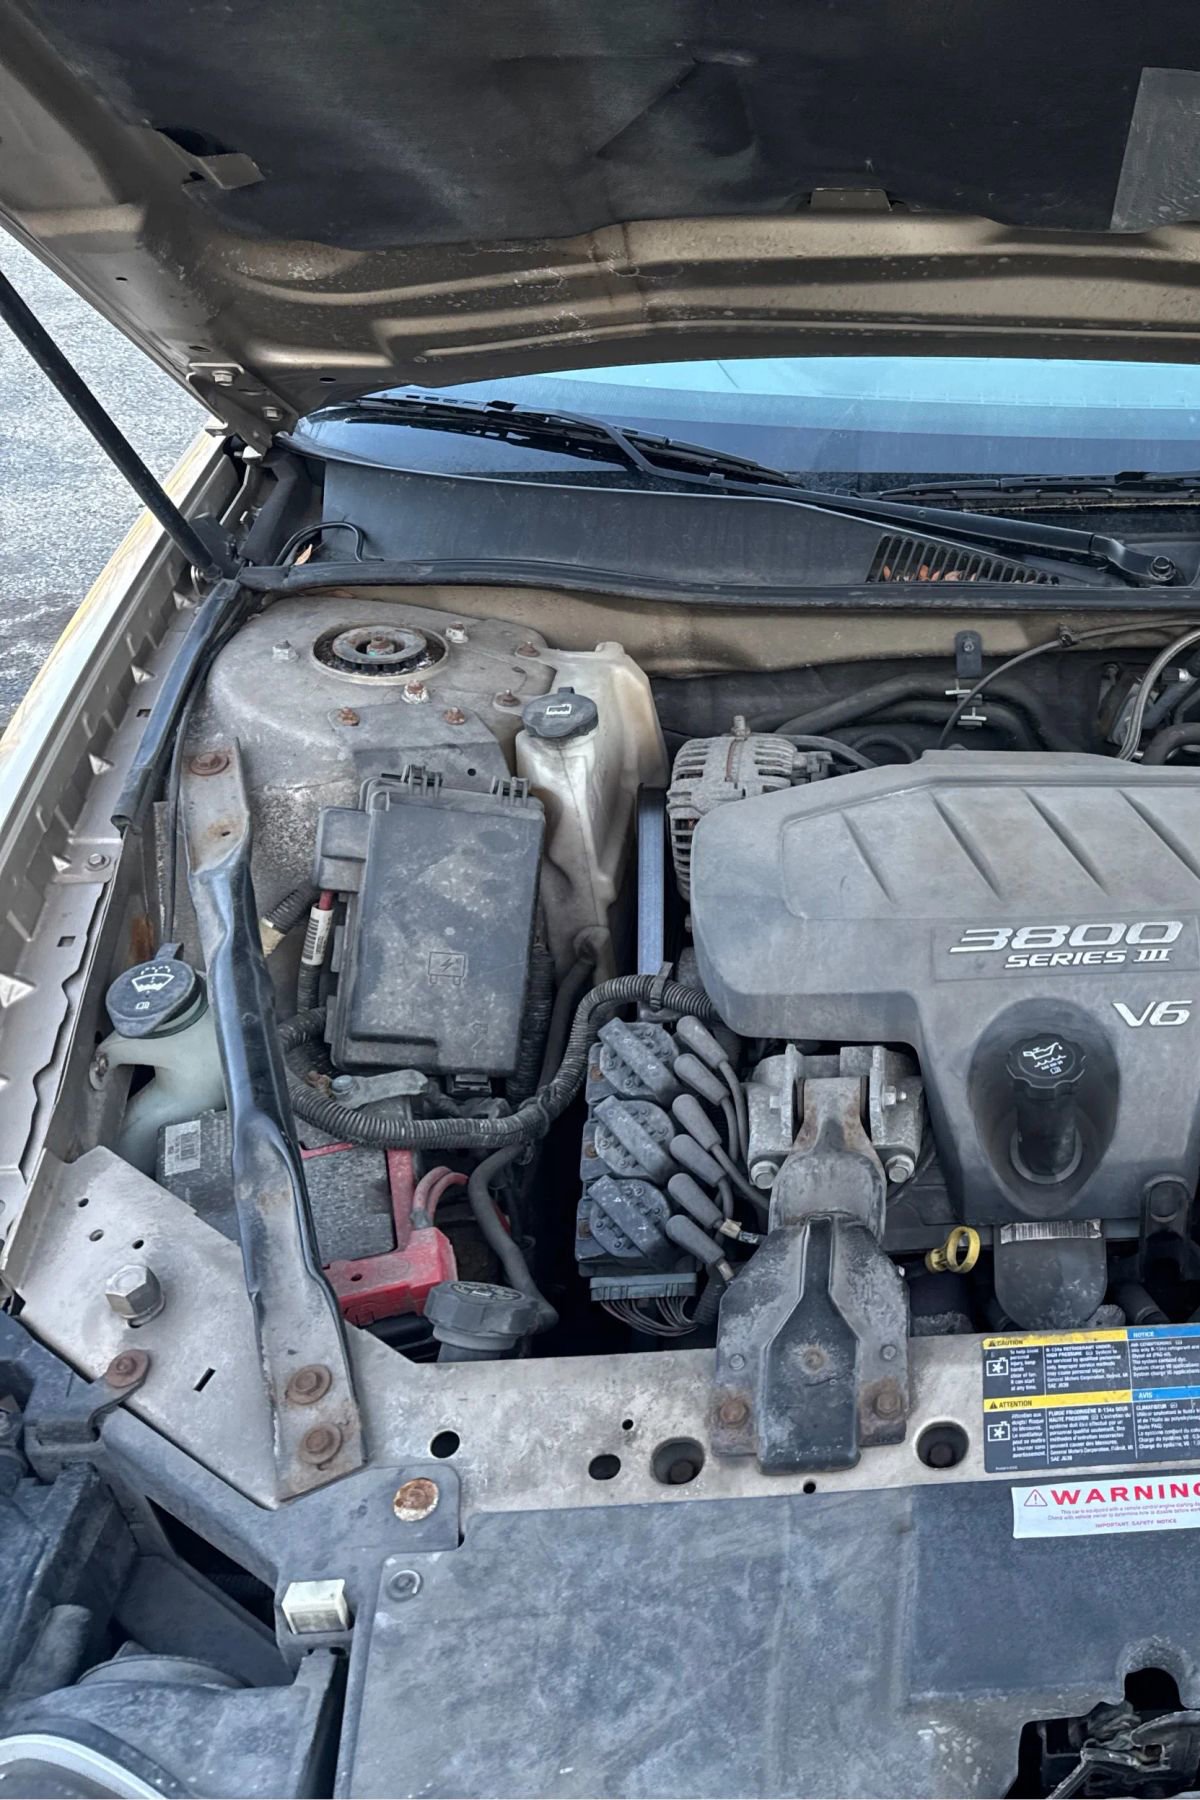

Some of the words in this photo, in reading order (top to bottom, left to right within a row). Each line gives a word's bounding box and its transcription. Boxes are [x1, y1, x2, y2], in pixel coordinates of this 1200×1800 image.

[950, 920, 1184, 953] 3800
[1004, 949, 1127, 969] SERIES
[1133, 948, 1173, 962] III
[1112, 1000, 1193, 1027] V6
[999, 1400, 1032, 1408] ATTENTION
